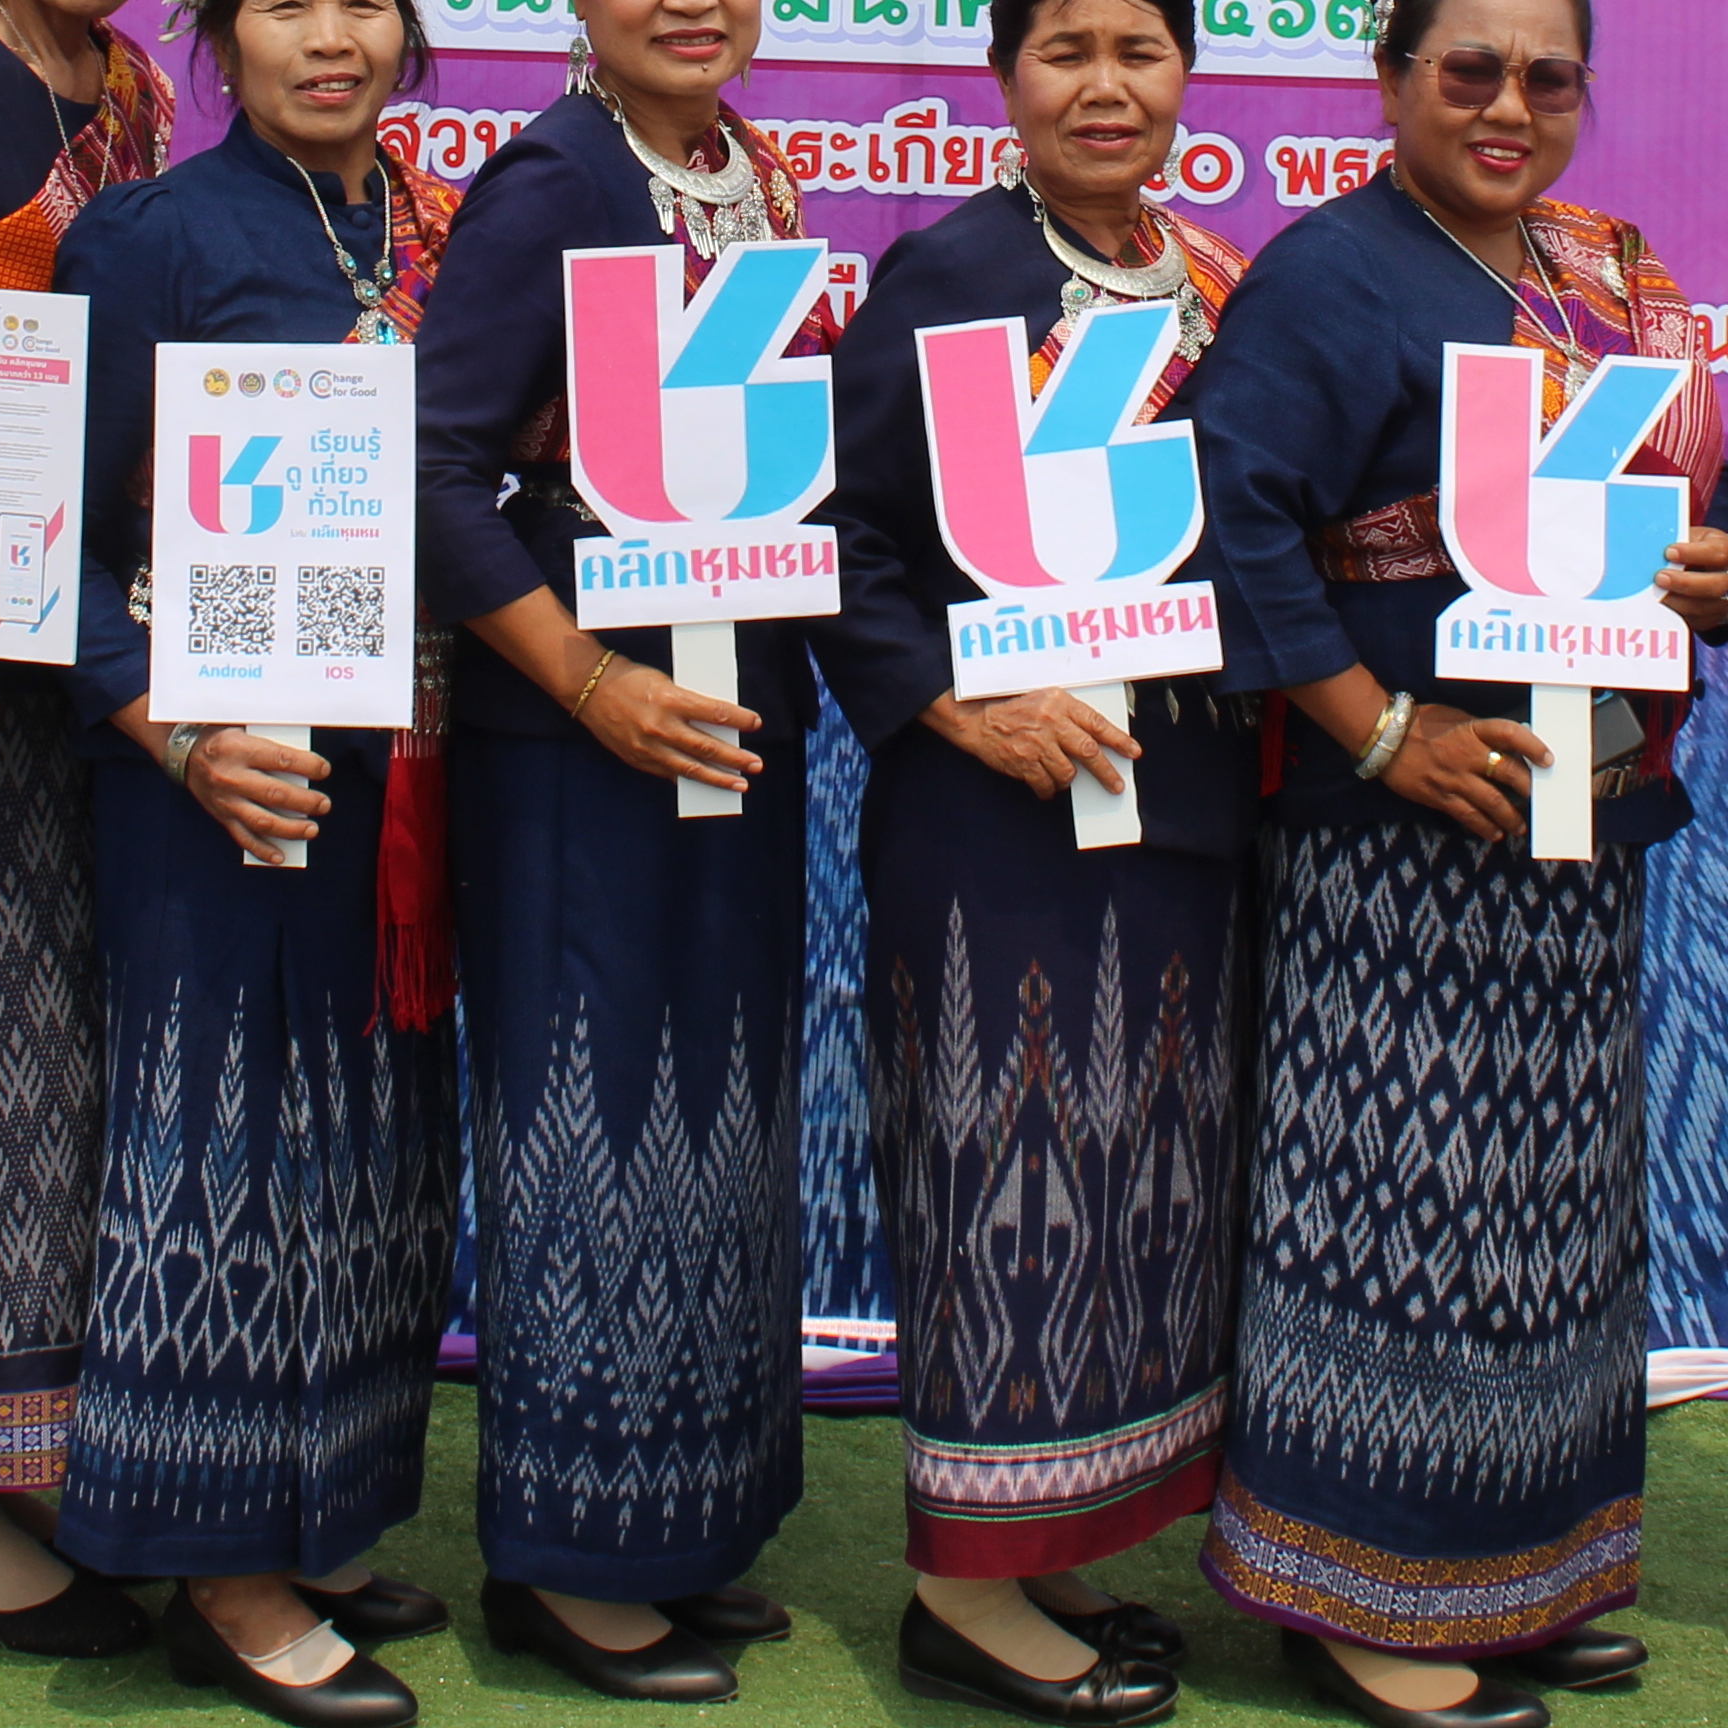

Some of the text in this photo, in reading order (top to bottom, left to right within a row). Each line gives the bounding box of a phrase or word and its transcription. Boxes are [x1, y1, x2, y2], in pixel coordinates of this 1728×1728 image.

[768, 109, 1029, 186] ระเกีย
[1275, 146, 1396, 197] พร
[332, 387, 378, 398] for Good
[310, 426, 383, 461] เรียนรู้
[285, 453, 369, 492] ดู เที่ยว
[308, 486, 383, 517] ทั่วไทย
[581, 539, 835, 598] คลิกชุมชน
[958, 595, 1214, 659] คลิกชุมชน
[1449, 608, 1679, 669] คลิกชุมชน
[198, 663, 355, 680] Android IOS
